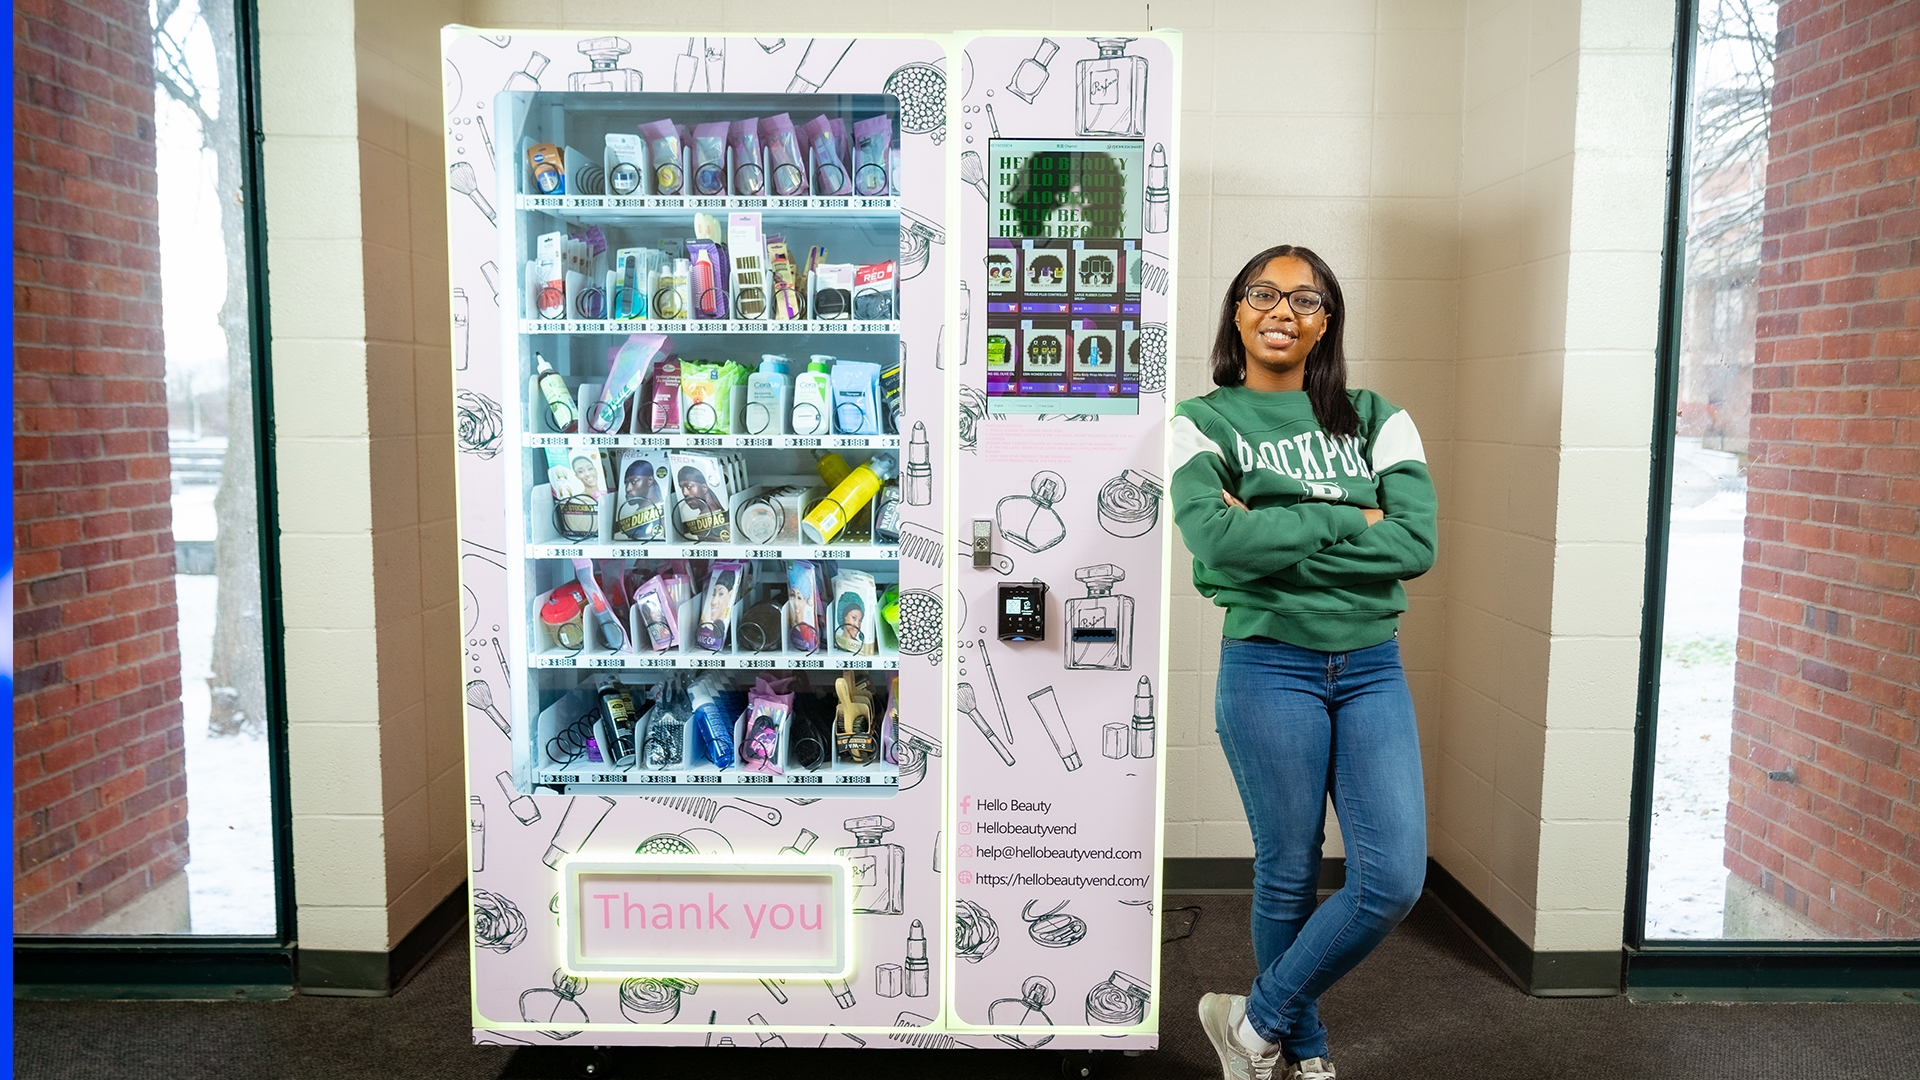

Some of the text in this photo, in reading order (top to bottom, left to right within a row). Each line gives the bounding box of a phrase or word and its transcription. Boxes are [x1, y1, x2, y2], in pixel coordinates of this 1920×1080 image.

[1000, 157, 1128, 170] HELLO BEAUTY
[1000, 173, 1128, 186] HELLO BEAUTY
[1000, 191, 1128, 205] HELLO BEAUTY
[1000, 209, 1127, 222] HELLO BEAUTY
[1000, 225, 1127, 238] HELLO BEAUTY
[864, 271, 885, 282] RED
[631, 505, 662, 527] DURAG
[696, 513, 725, 530] DURAG
[977, 799, 1051, 814] Hello Beauty
[976, 822, 1077, 837] Hellobeautyvend
[976, 846, 1142, 862] help@hellobeautyvend.com
[976, 873, 1150, 889] https://hellobeautyvend.com/
[593, 892, 821, 938] Thank you
